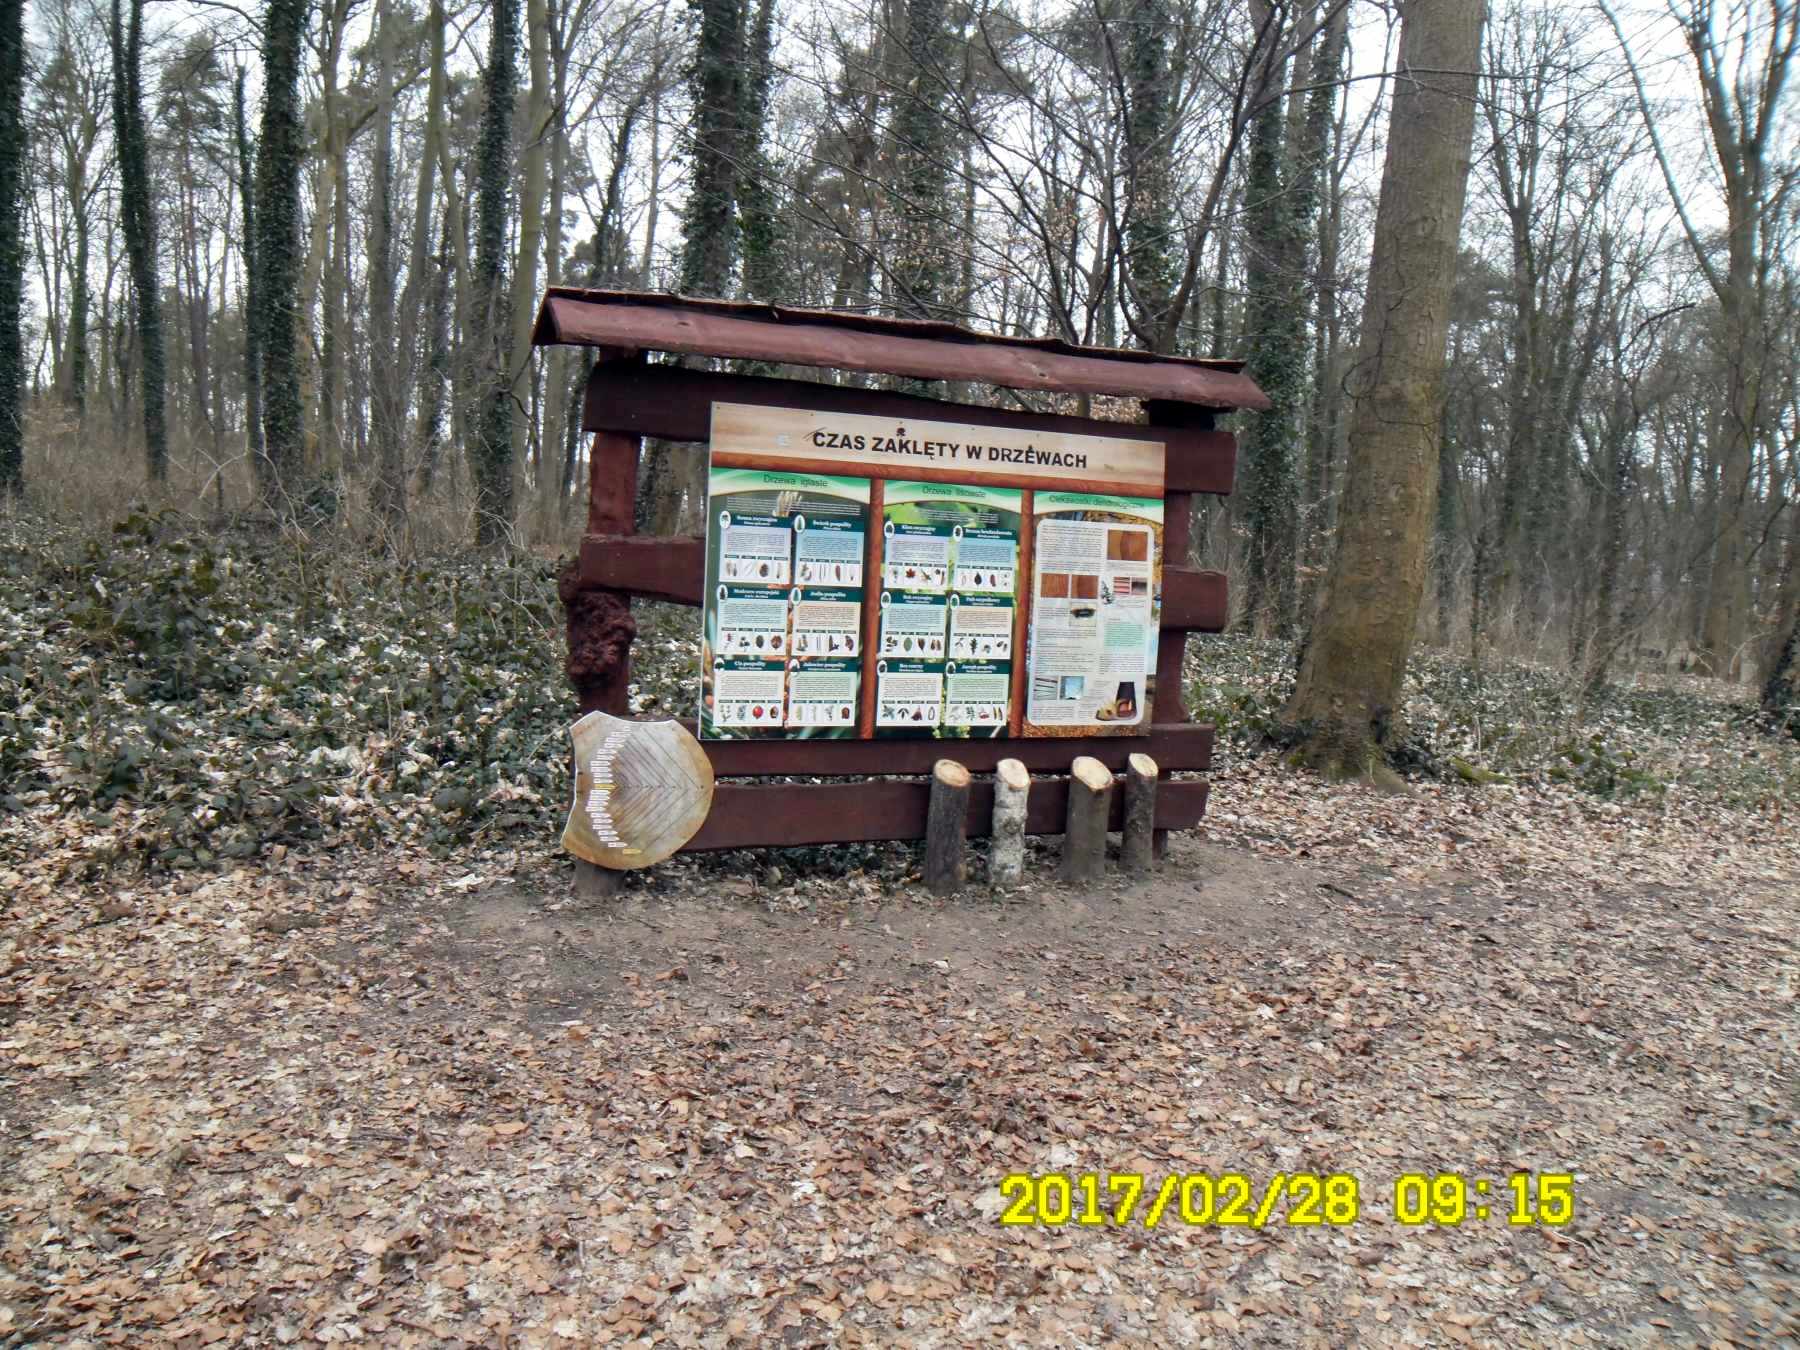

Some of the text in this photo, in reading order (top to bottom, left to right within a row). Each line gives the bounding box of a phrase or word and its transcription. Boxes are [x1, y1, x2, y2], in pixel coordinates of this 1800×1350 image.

[812, 431, 1088, 470] CZAS ZAKLĘTY W DRZEWACH
